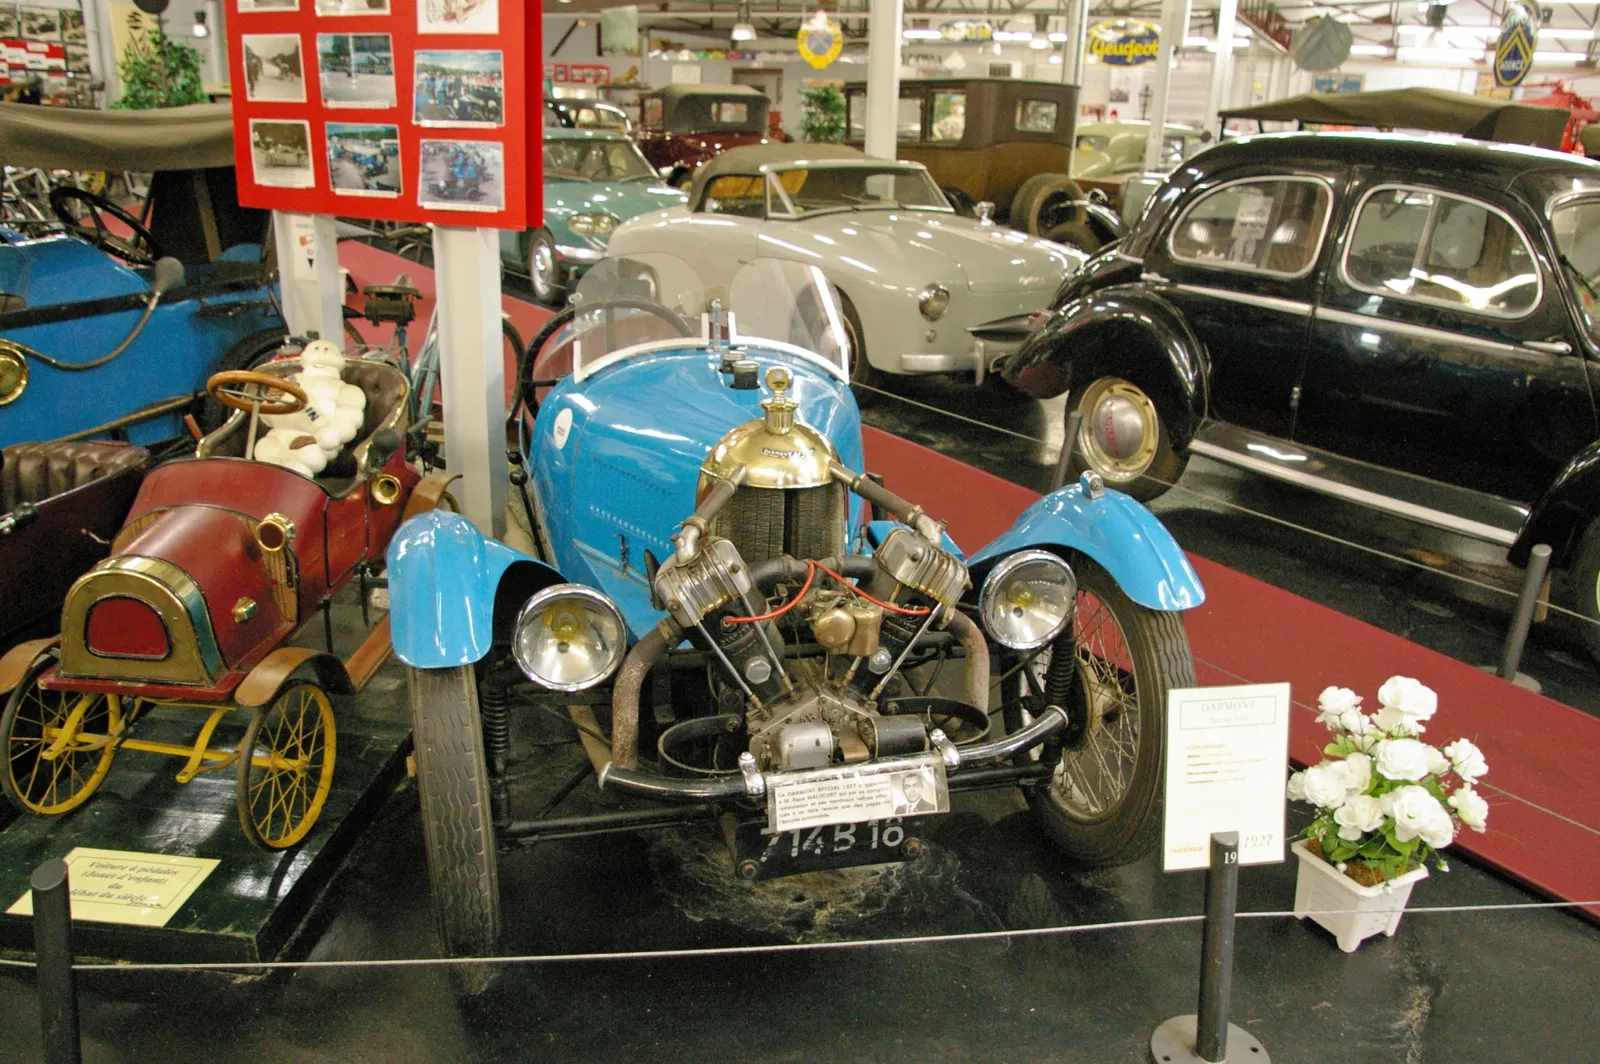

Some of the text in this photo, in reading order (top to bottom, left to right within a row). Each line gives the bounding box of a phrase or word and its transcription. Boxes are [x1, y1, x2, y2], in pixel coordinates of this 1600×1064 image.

[1200, 699, 1257, 713] DARMONT
[1243, 834, 1274, 849] 1927
[1223, 851, 1238, 865] 19
[108, 882, 124, 890] du
